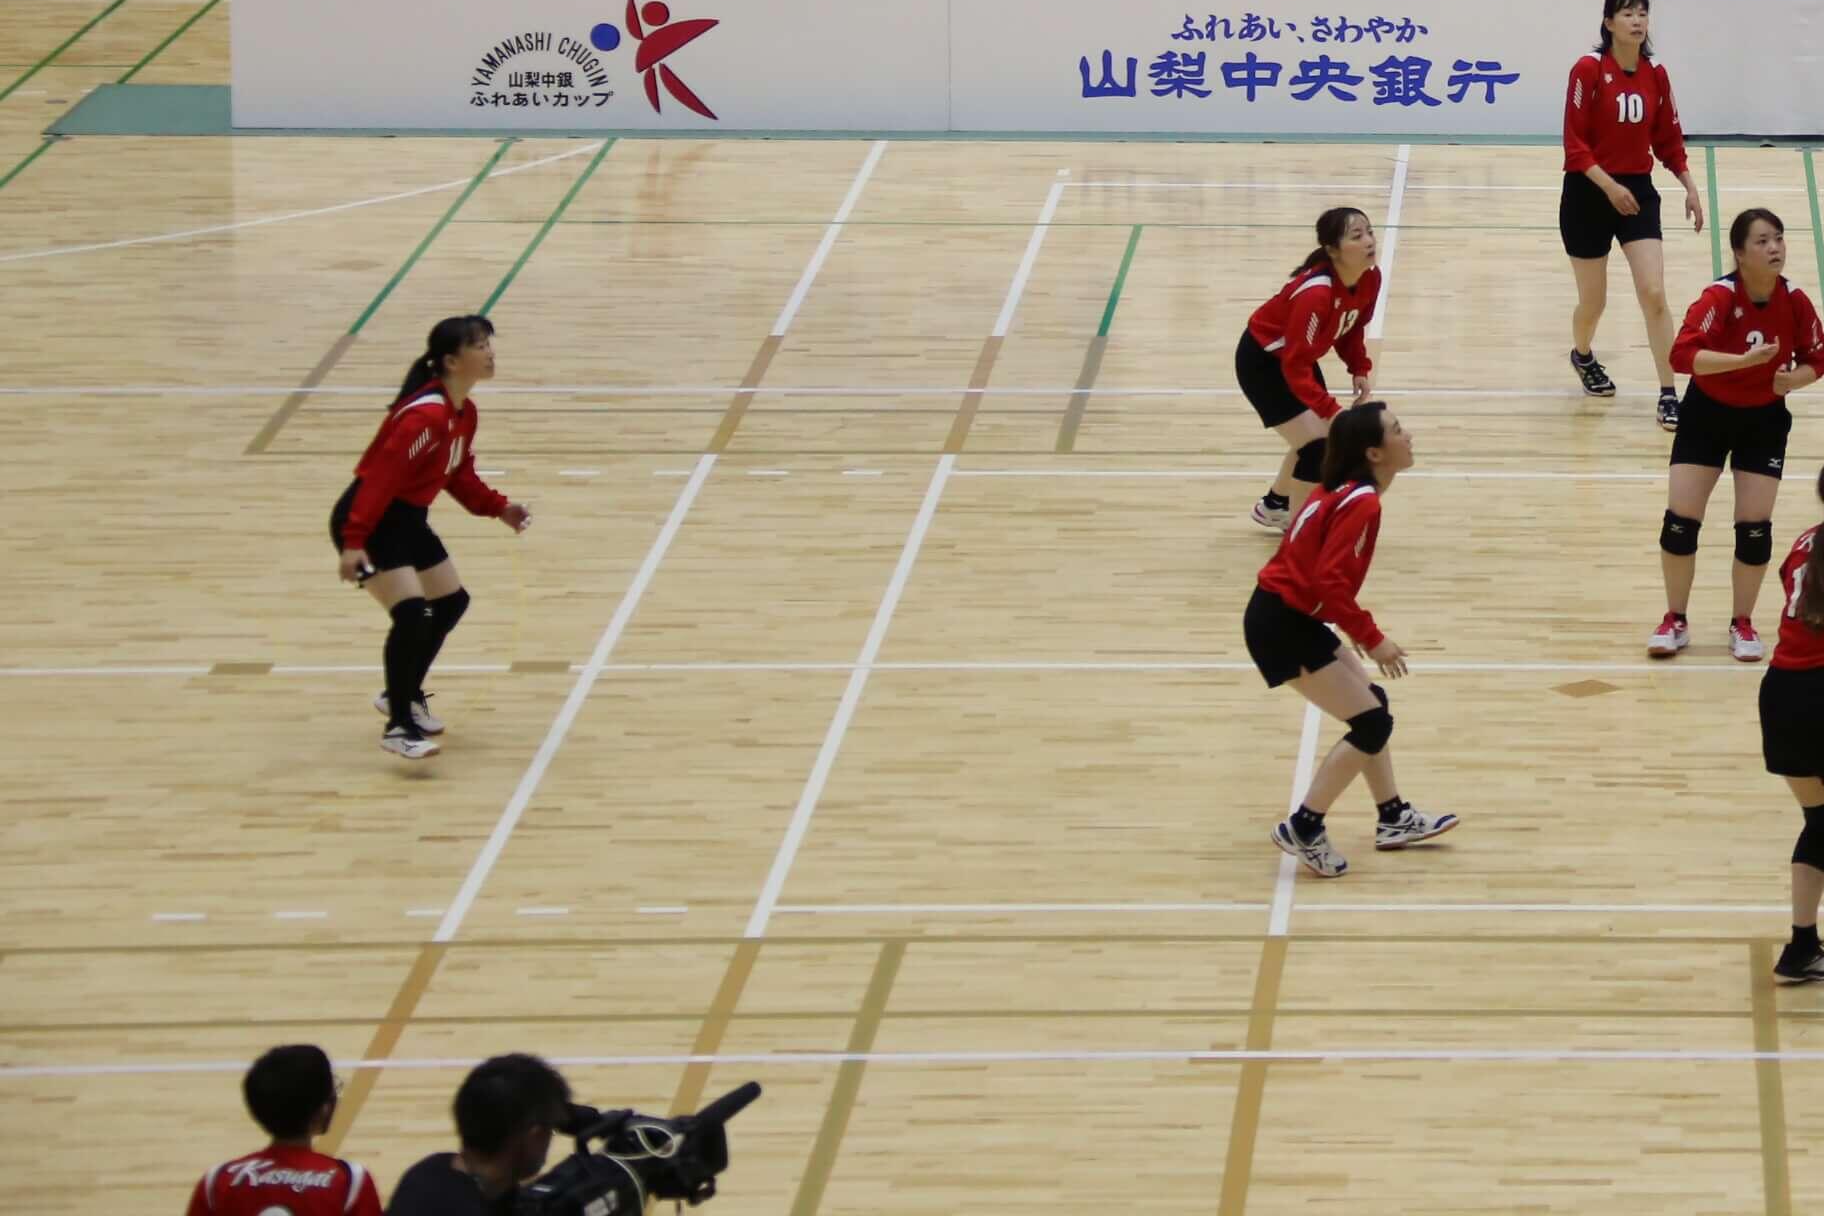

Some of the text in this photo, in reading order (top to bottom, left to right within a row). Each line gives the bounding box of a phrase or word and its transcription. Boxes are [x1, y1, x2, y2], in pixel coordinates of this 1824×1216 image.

[471, 31, 609, 88] YAMANASHI CHUGIN
[509, 72, 574, 88] 山梨中銀
[1079, 48, 1522, 107] 山梨中央銀行
[470, 91, 614, 108] ふれあいカップ
[1615, 92, 1645, 124] 10
[1334, 308, 1360, 340] 13
